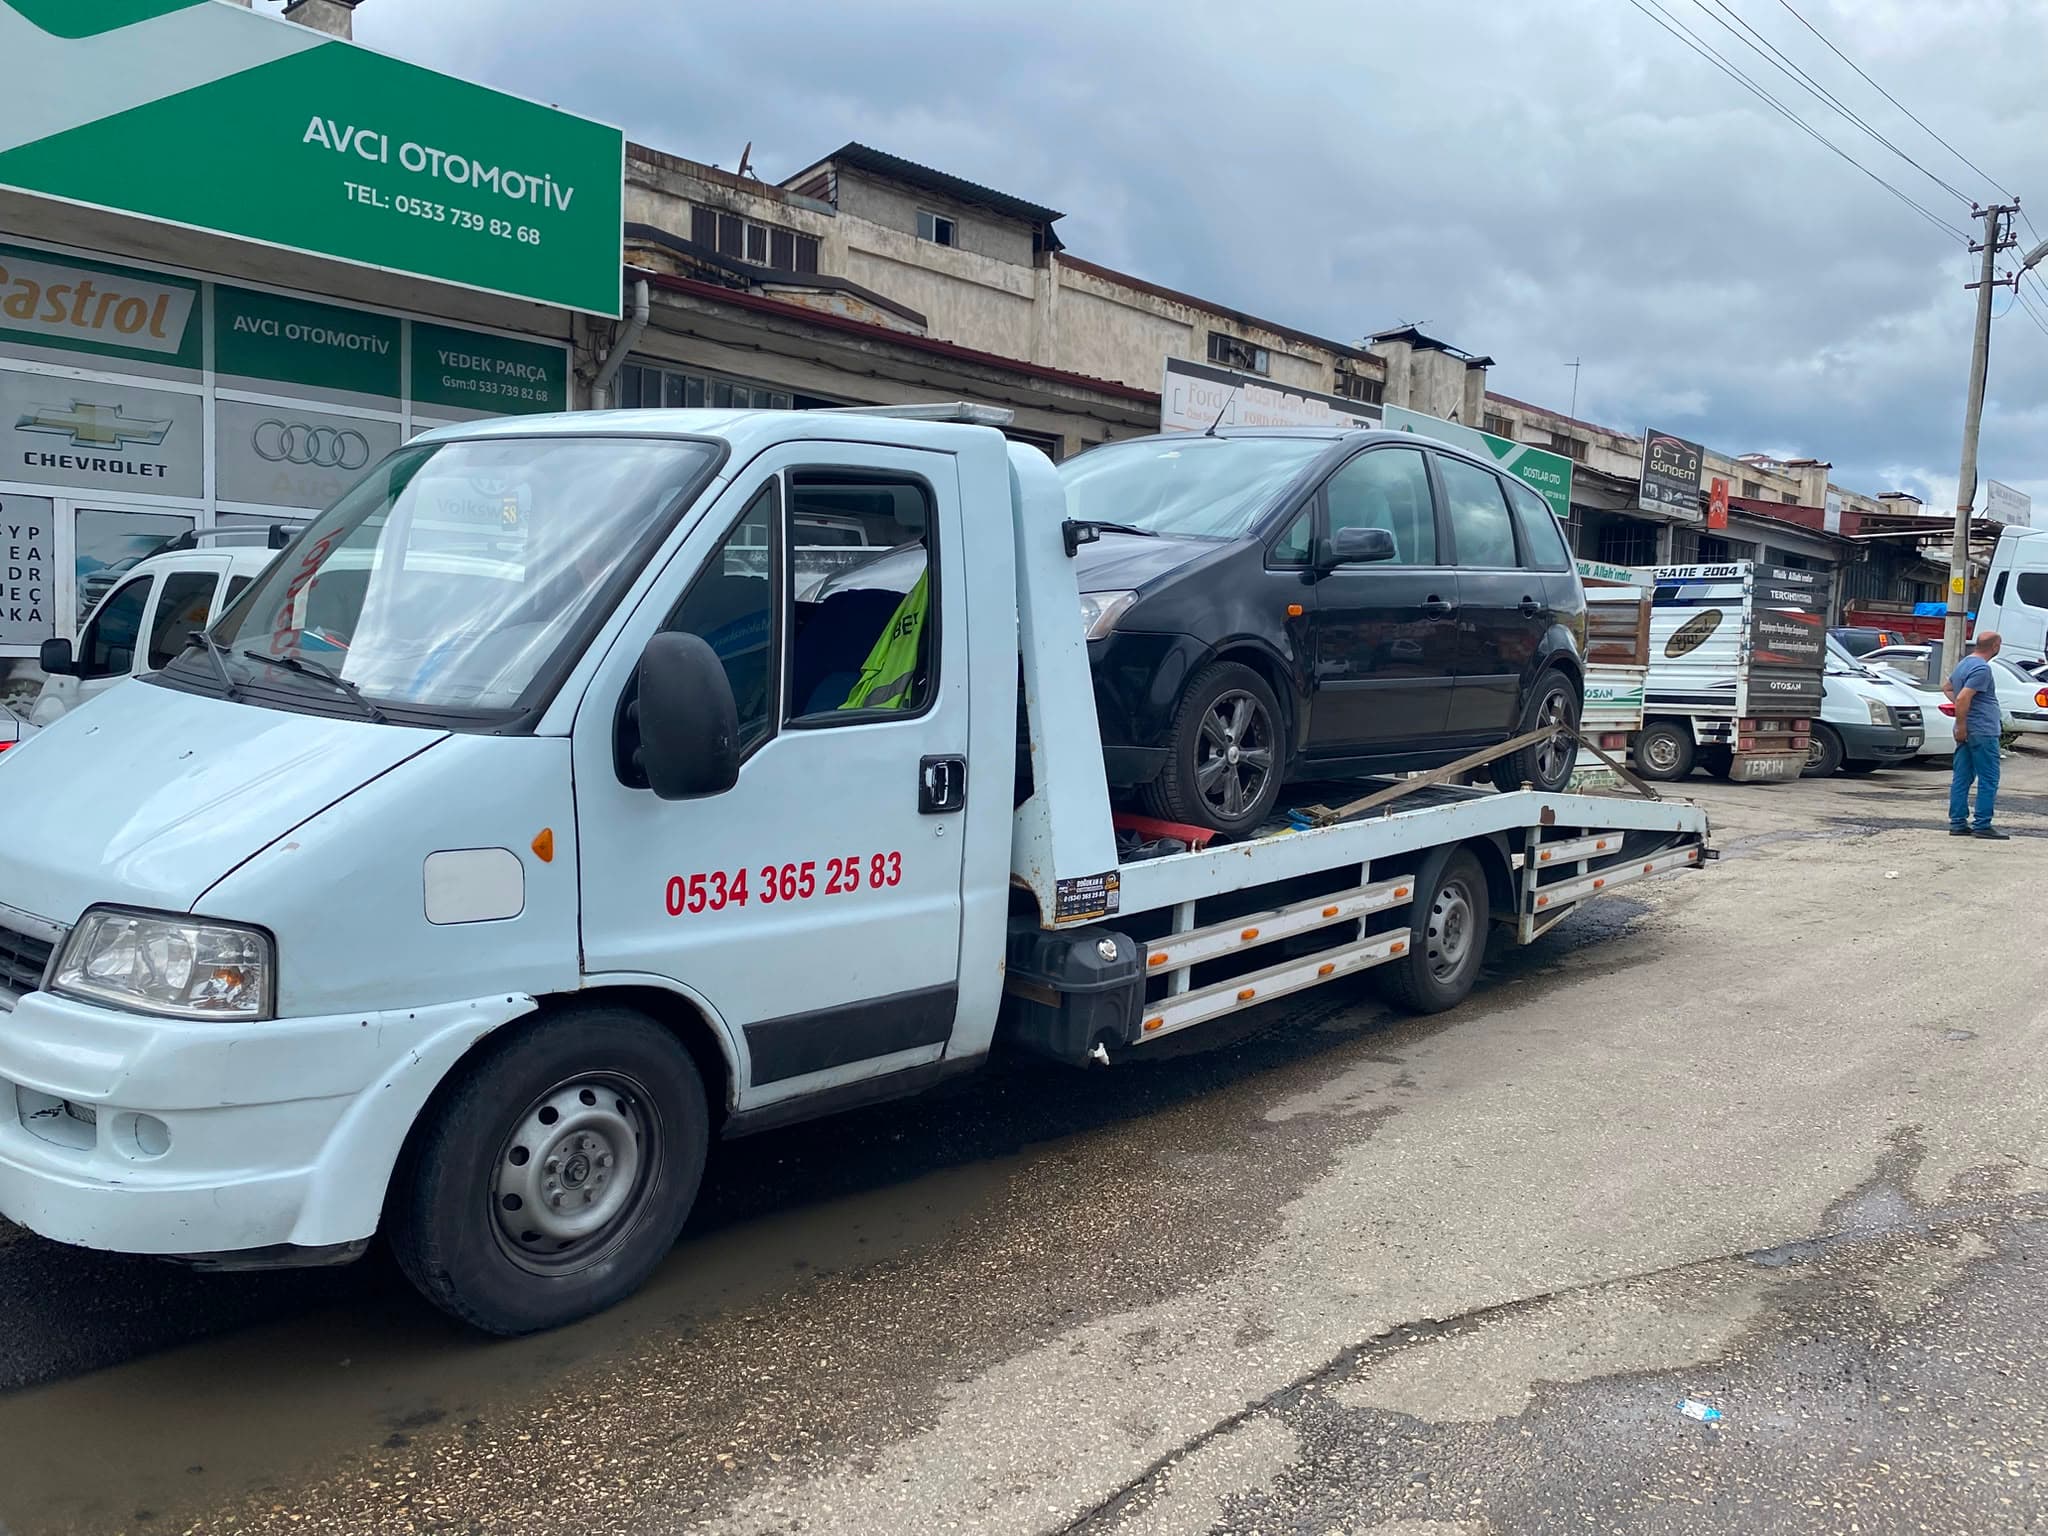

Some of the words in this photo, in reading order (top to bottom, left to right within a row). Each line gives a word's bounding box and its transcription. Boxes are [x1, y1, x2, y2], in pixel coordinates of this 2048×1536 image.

[303, 116, 388, 164] AVCI
[399, 141, 574, 212] OTOMOTİV
[343, 181, 390, 209] TEL:
[395, 195, 446, 222] 0533
[450, 208, 485, 232] 739
[489, 219, 513, 239] 82
[516, 226, 541, 246] 68
[0, 265, 170, 339] astrol
[233, 315, 280, 337] AVCI
[285, 324, 390, 355] OTOMOTİV
[438, 350, 492, 374] YEDEK
[496, 361, 548, 383] PARÇA
[479, 381, 498, 396] 533
[500, 385, 520, 399] 739
[521, 389, 534, 401] 82
[536, 390, 548, 403] 68
[24, 451, 168, 478] CHEVROLET
[1650, 460, 1696, 481] GÜNDEM
[1703, 566, 1738, 577] 2004
[665, 868, 749, 917] 0534
[759, 861, 816, 904] 365
[824, 856, 860, 895] 25
[869, 851, 902, 889] 83
